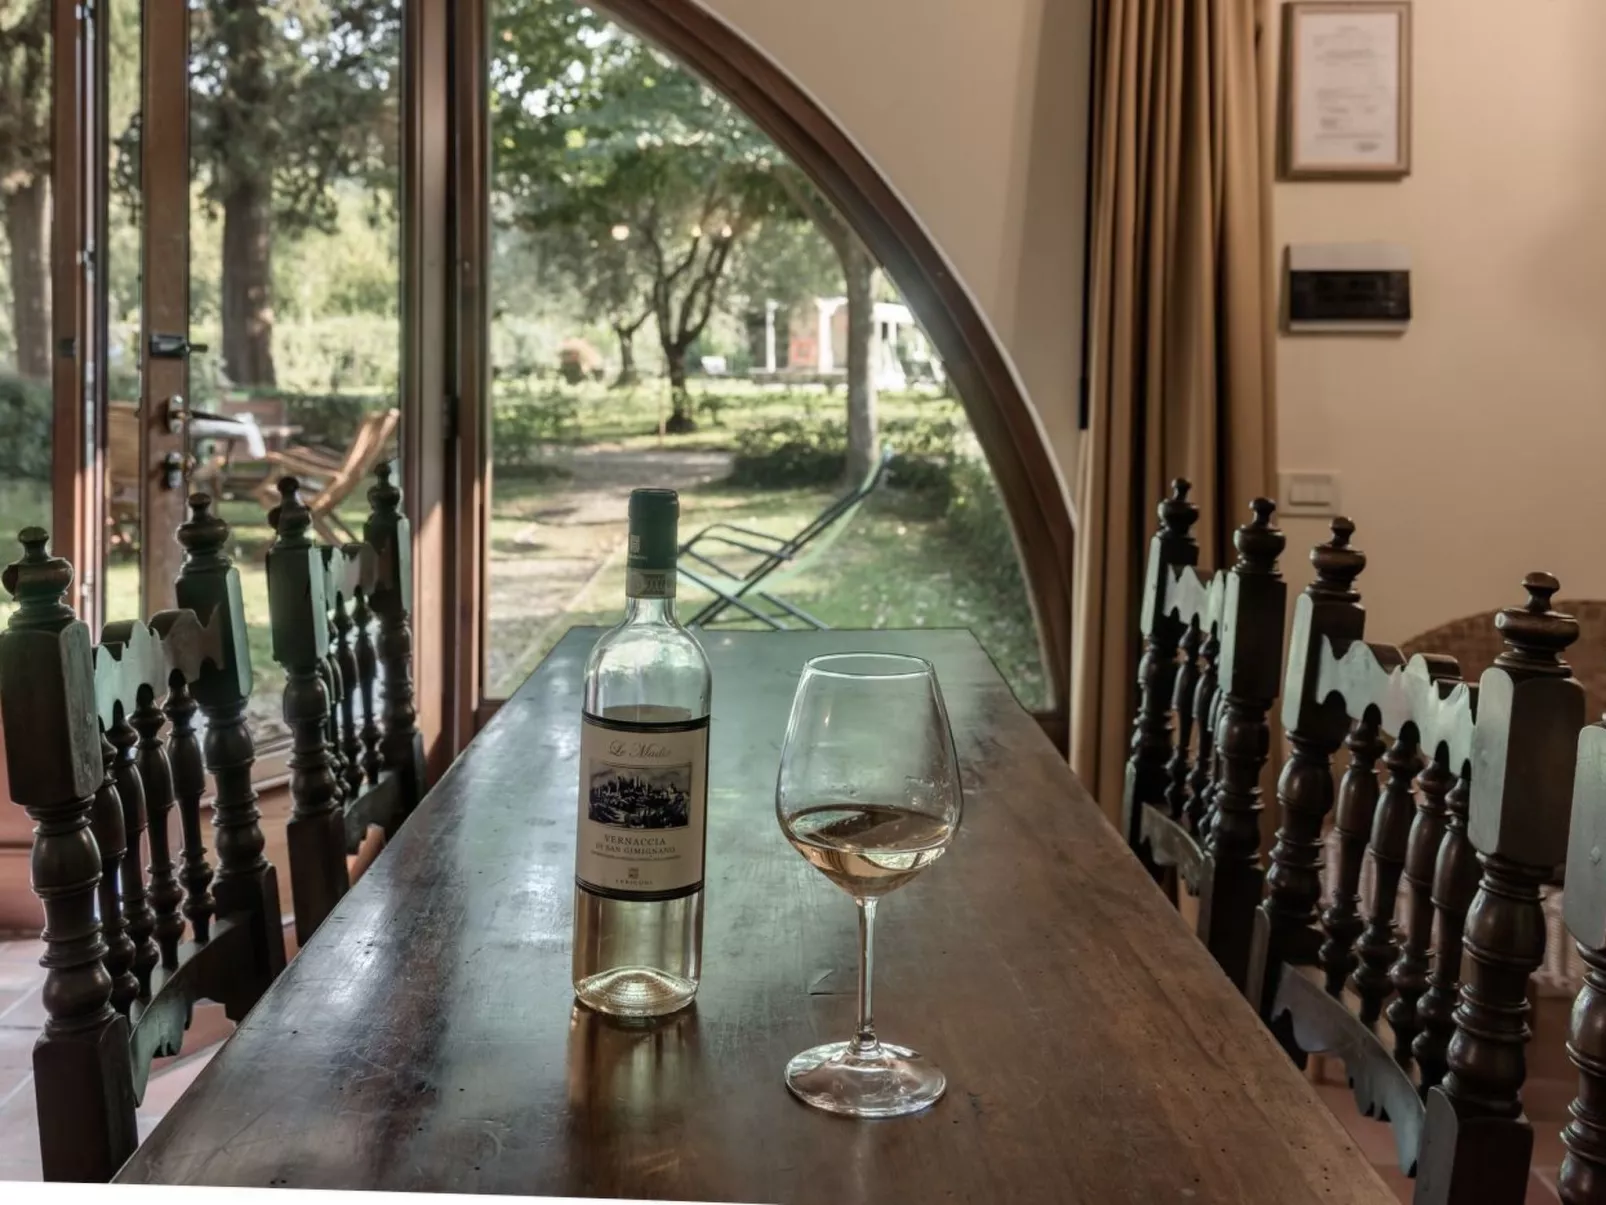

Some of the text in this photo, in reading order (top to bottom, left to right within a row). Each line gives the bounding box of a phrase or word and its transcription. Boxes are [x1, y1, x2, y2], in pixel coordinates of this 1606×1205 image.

[604, 834, 667, 846] VERNACCIA
[605, 845, 621, 853] SAN
[624, 846, 676, 854] GIMIGNANO
